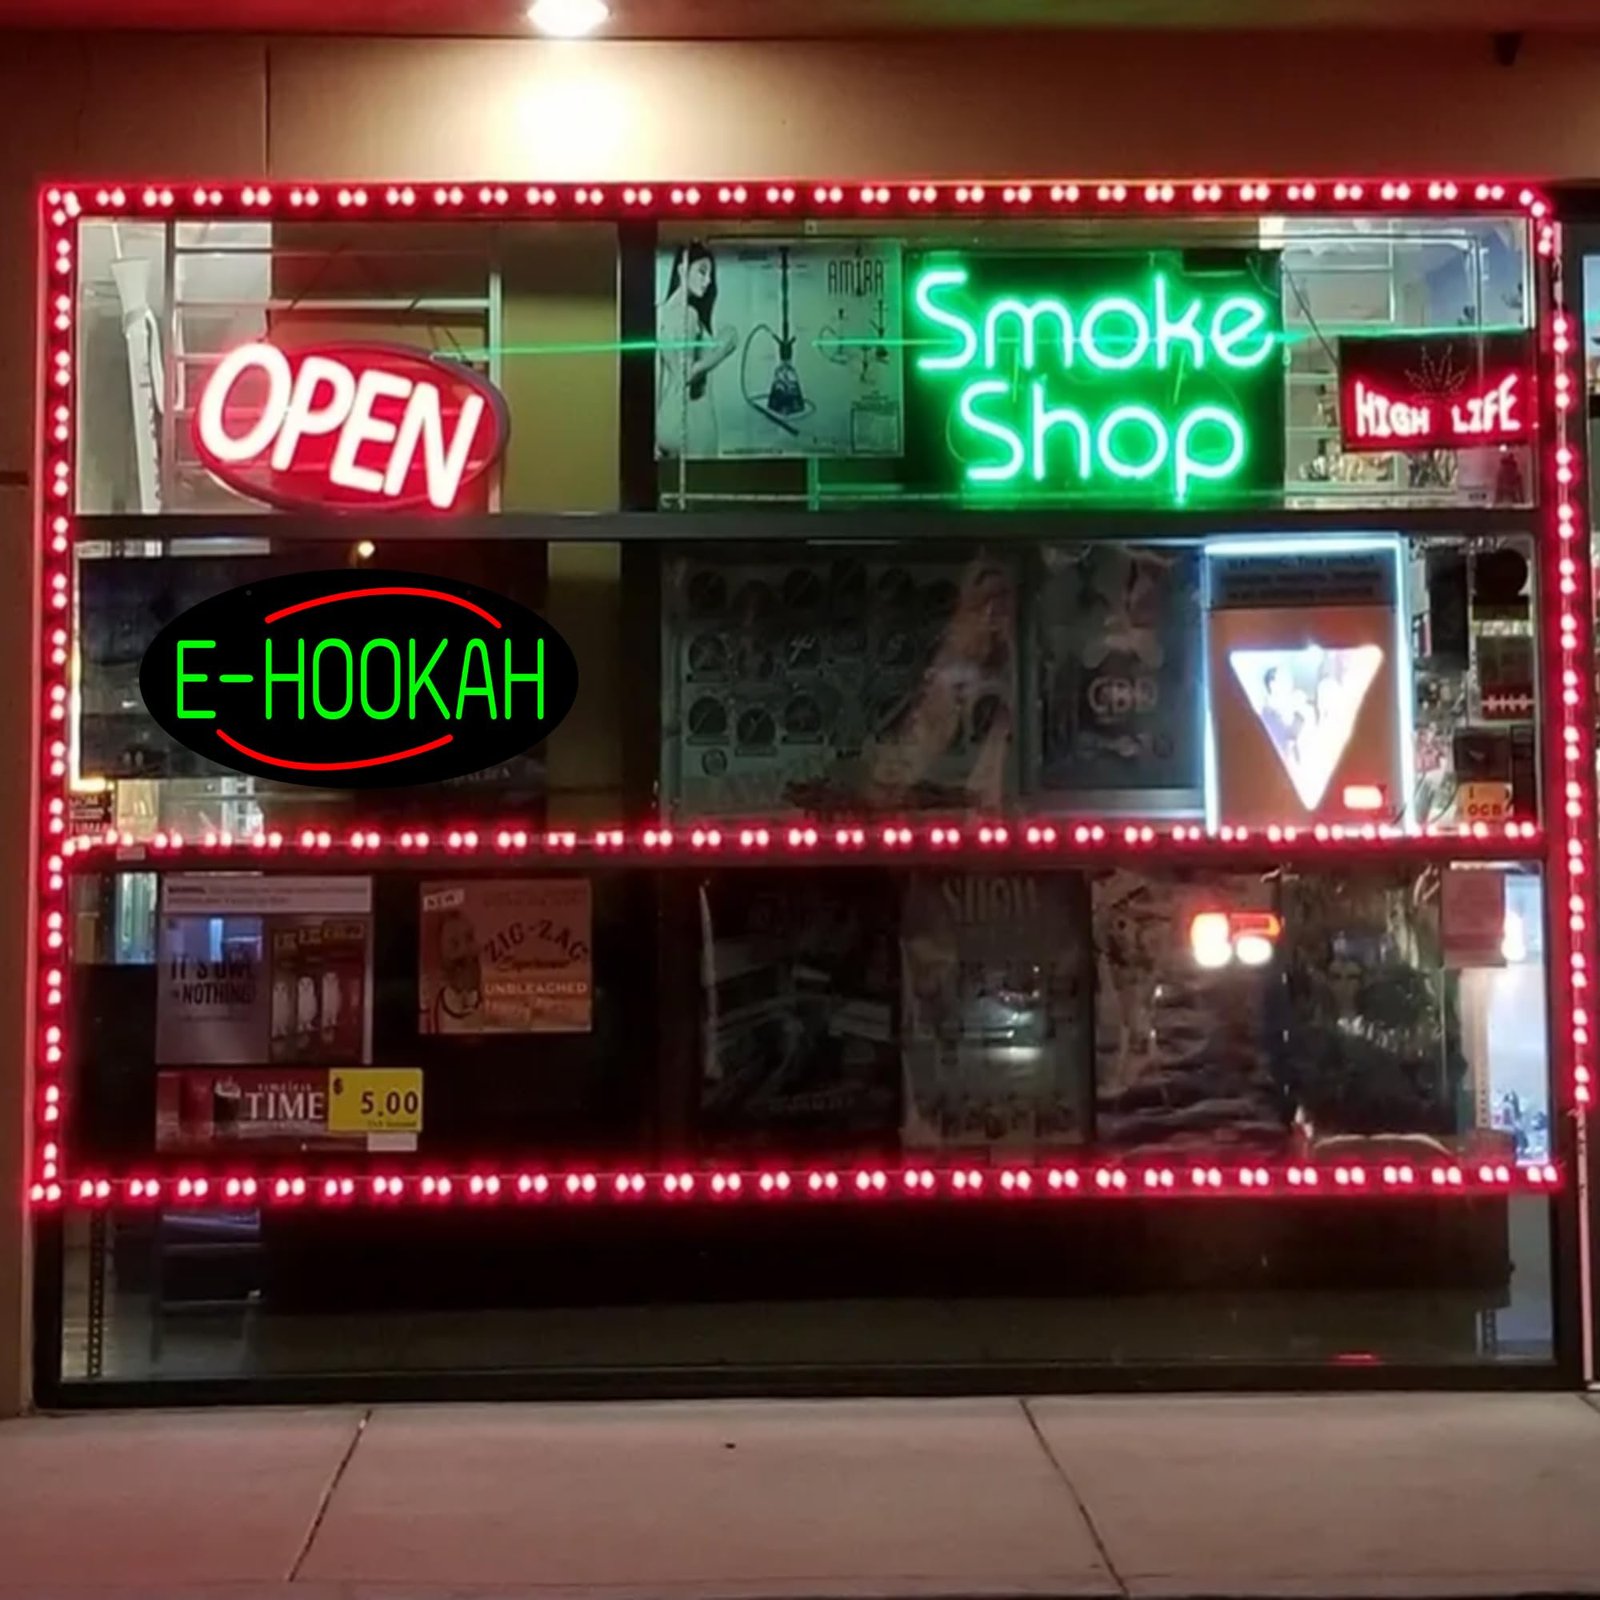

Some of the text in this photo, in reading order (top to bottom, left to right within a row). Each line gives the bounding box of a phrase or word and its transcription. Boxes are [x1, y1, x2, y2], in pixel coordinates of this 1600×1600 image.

[828, 259, 884, 296] AMIRA
[914, 268, 1276, 372] Smoke
[197, 341, 486, 510] OPEN
[1355, 373, 1522, 438] HIGH LIFE
[958, 379, 1250, 503] Shop
[175, 637, 546, 721] E-HOOKAH
[483, 919, 589, 963] ZIG-ZAG
[484, 982, 588, 995] UNBLEACHED
[244, 1091, 325, 1119] TIME
[360, 1090, 418, 1117] 5.00
